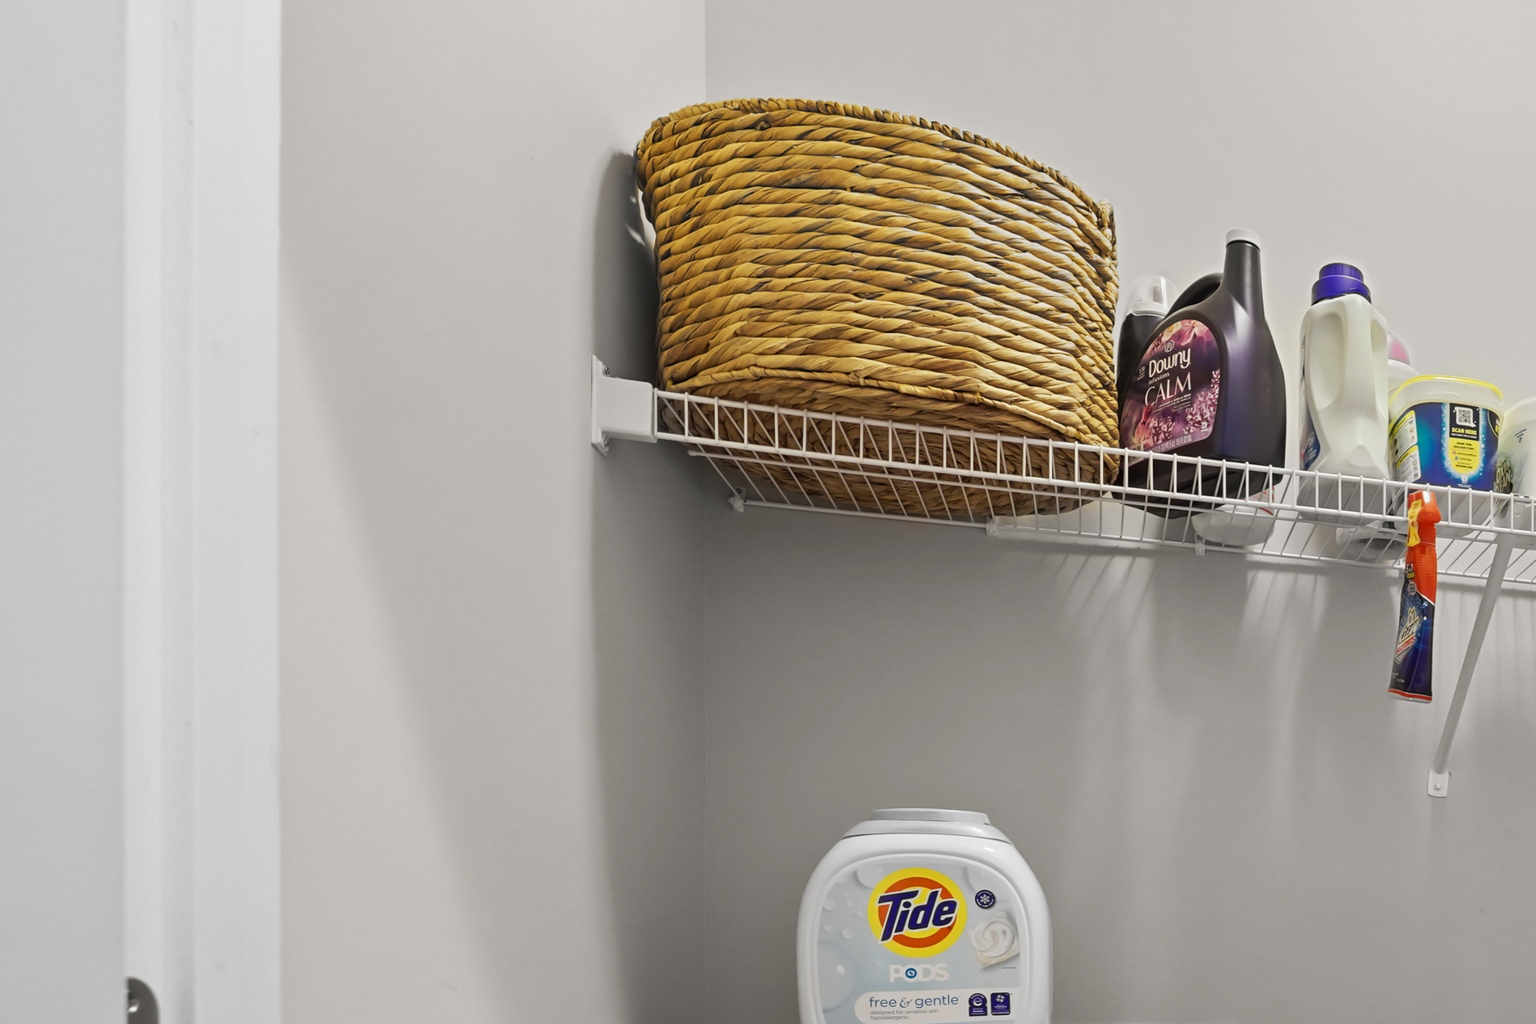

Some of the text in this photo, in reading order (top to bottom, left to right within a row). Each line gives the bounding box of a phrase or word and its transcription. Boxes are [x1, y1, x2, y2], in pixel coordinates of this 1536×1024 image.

[1148, 348, 1191, 378] Downy
[1145, 372, 1192, 406] CALM
[876, 888, 958, 944] Tide
[889, 963, 950, 982] PODS
[869, 996, 897, 1008] free
[900, 997, 912, 1008] &
[914, 995, 958, 1008] gentle
